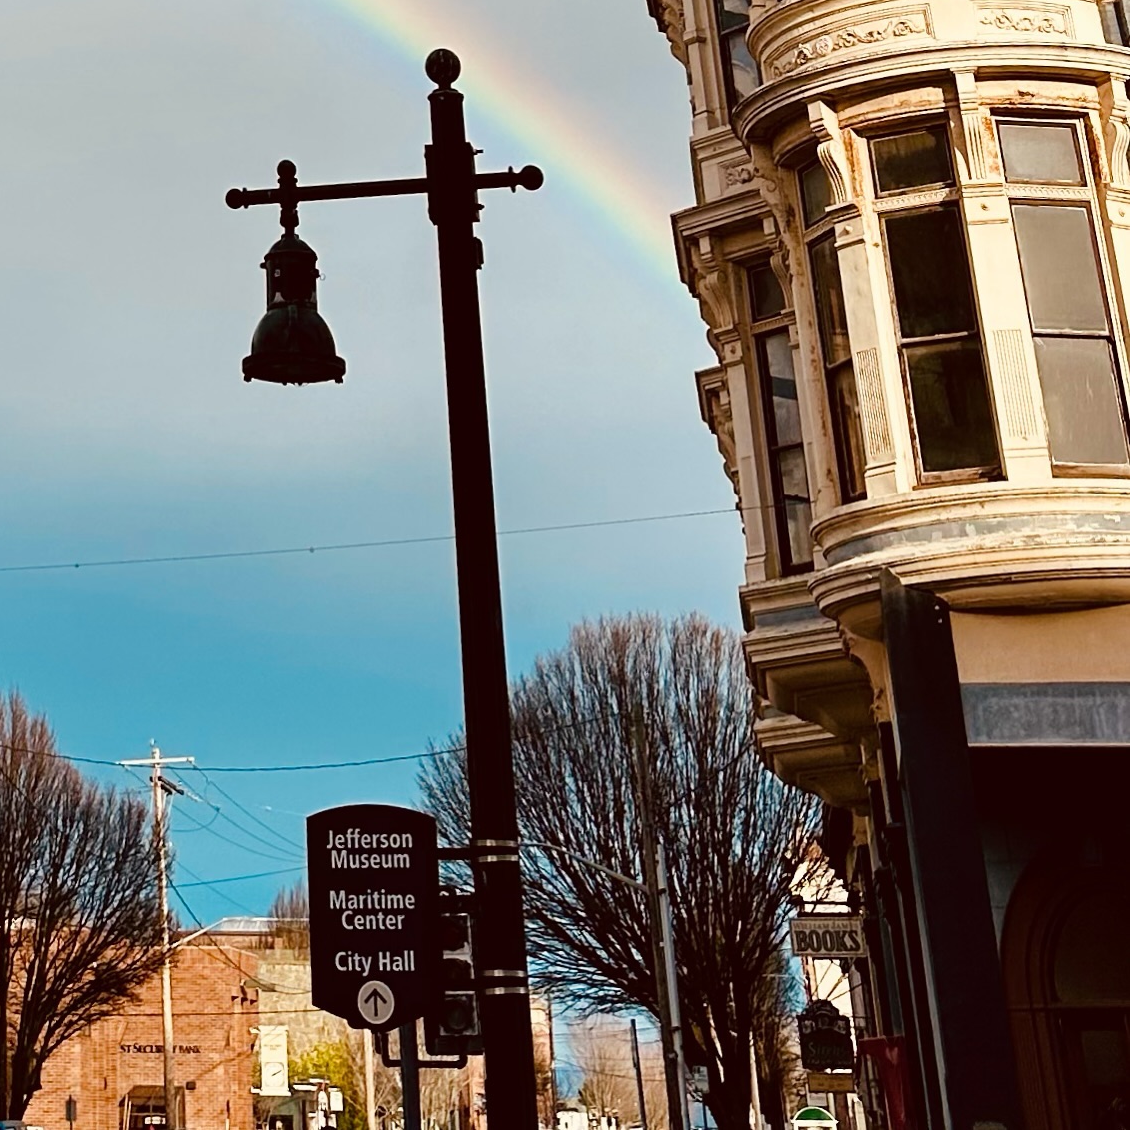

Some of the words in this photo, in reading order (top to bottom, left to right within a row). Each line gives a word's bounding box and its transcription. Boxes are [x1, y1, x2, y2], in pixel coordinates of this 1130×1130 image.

[327, 828, 413, 849] Jefferson
[331, 850, 410, 869] Museum
[329, 889, 416, 909] Maritime
[341, 911, 405, 930] Center
[795, 930, 861, 952] BOOKS
[335, 951, 372, 976] City
[378, 950, 415, 971] Hall
[179, 1044, 201, 1054] BANK
